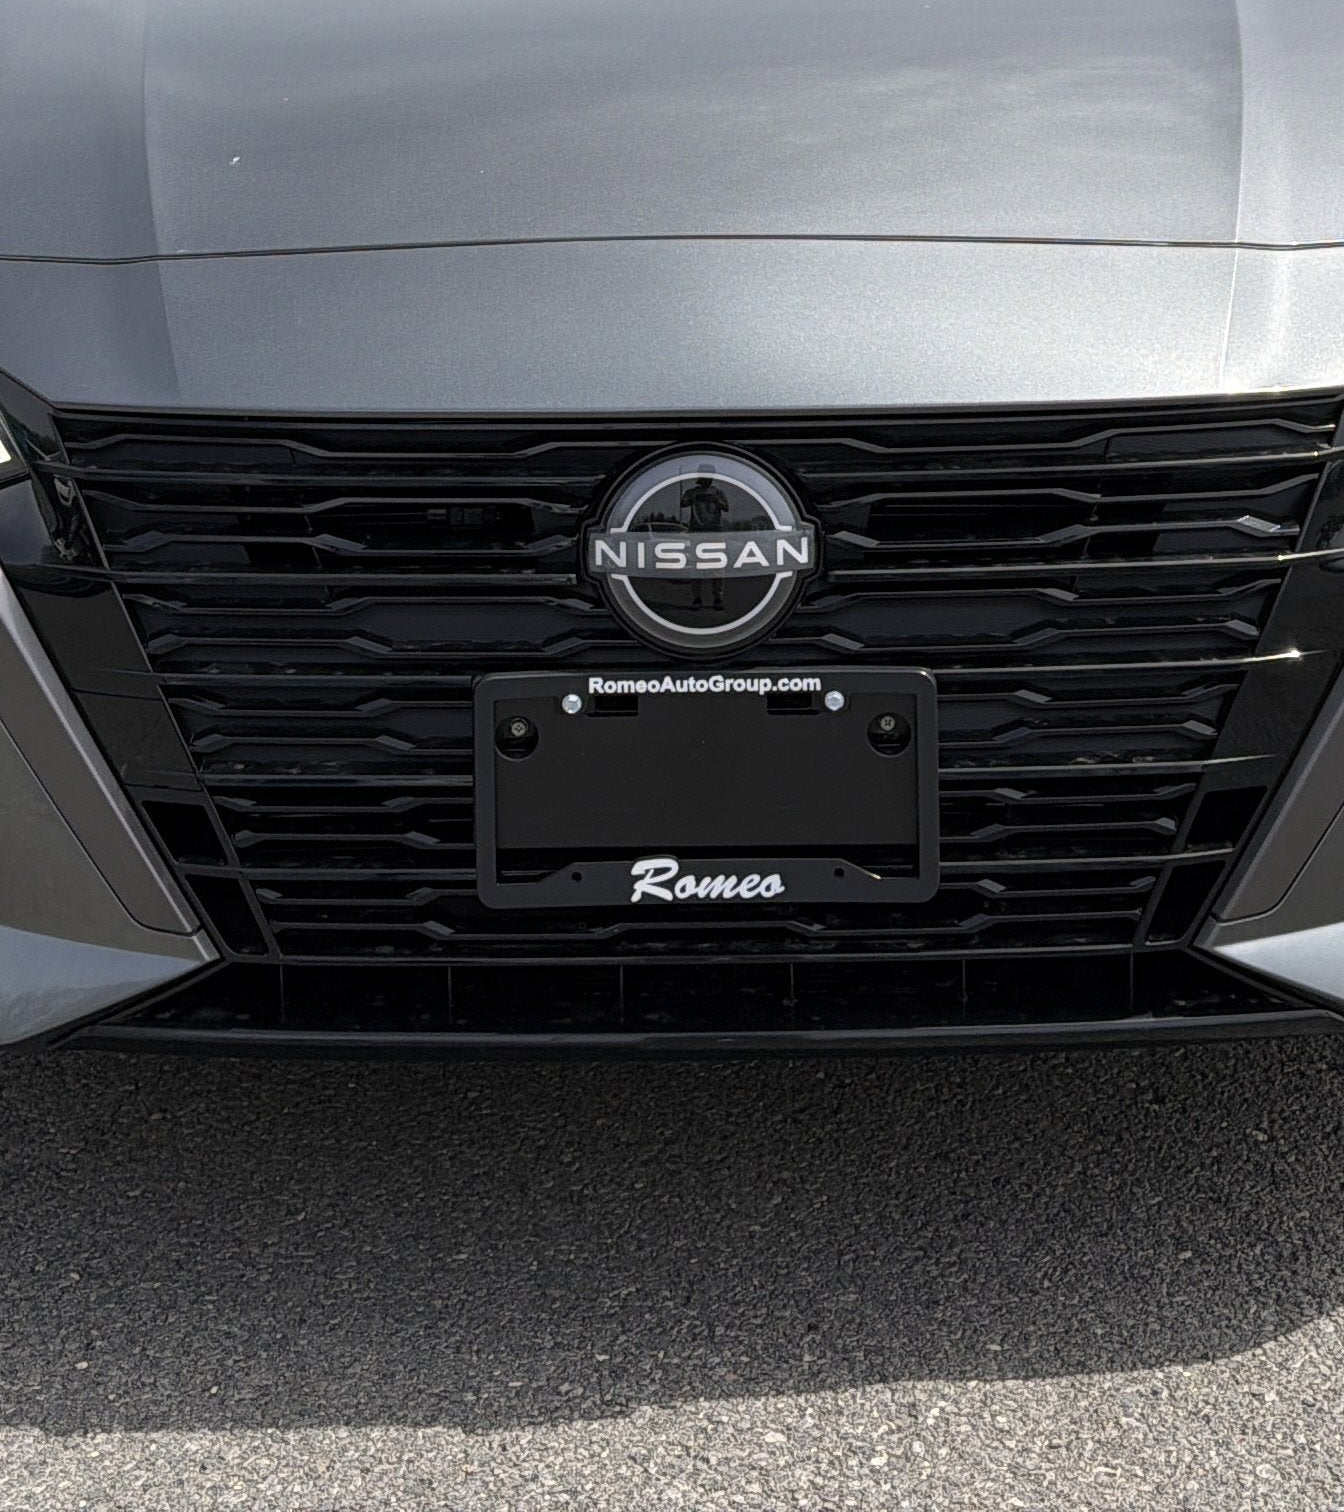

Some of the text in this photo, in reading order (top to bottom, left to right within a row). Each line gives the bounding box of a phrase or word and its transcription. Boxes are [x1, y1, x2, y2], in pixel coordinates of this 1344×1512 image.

[594, 536, 809, 570] NISSAN
[588, 675, 822, 696] RomeoAutoGroup.com
[630, 858, 786, 903] Romeo
